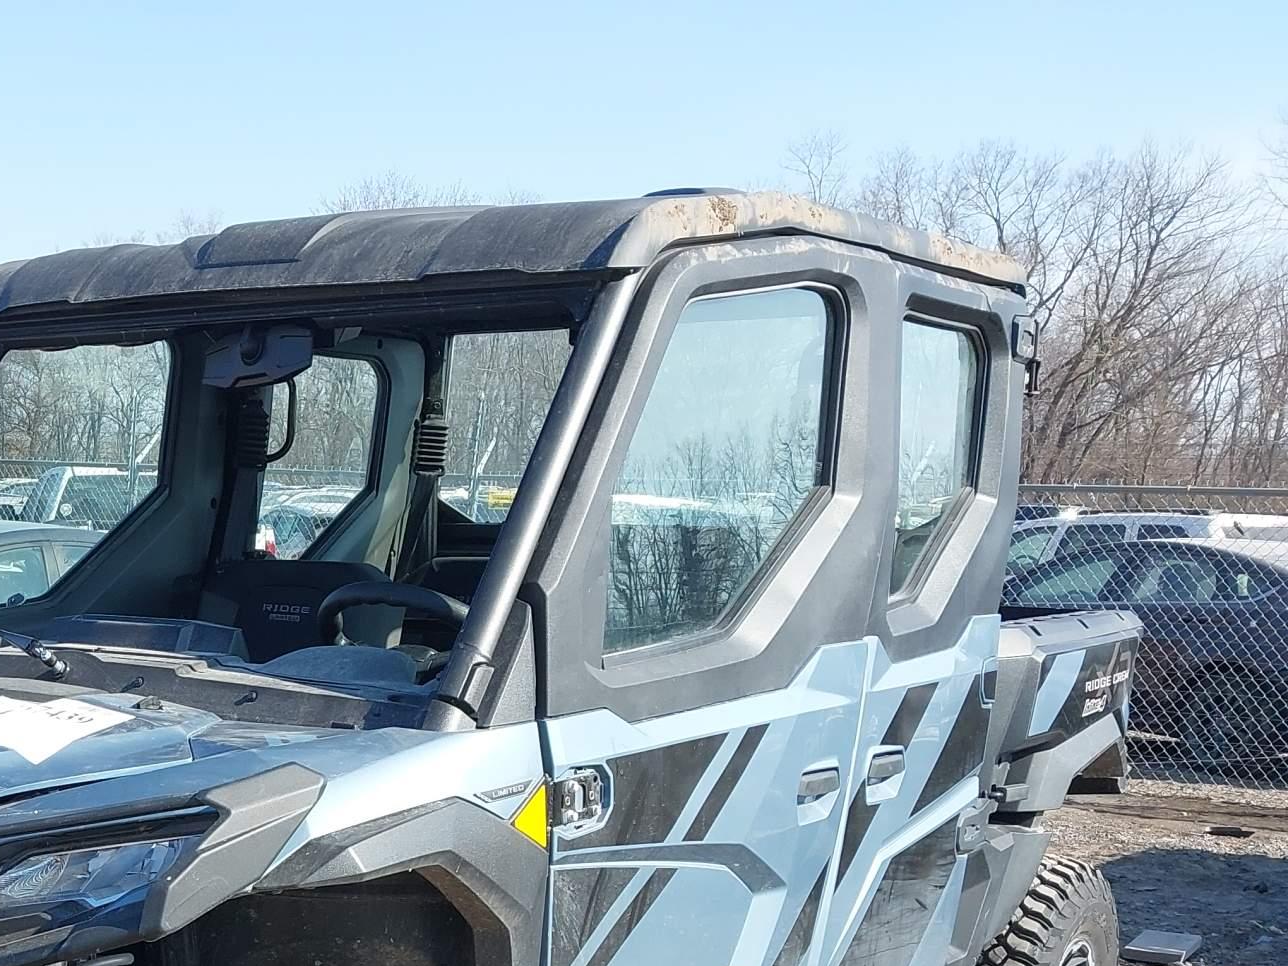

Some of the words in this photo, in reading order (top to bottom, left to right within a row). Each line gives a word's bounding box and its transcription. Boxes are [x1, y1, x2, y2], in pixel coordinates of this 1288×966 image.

[263, 603, 313, 614] RIDGE
[1085, 677, 1112, 693] RIDGE
[492, 785, 525, 798] LIMITED
